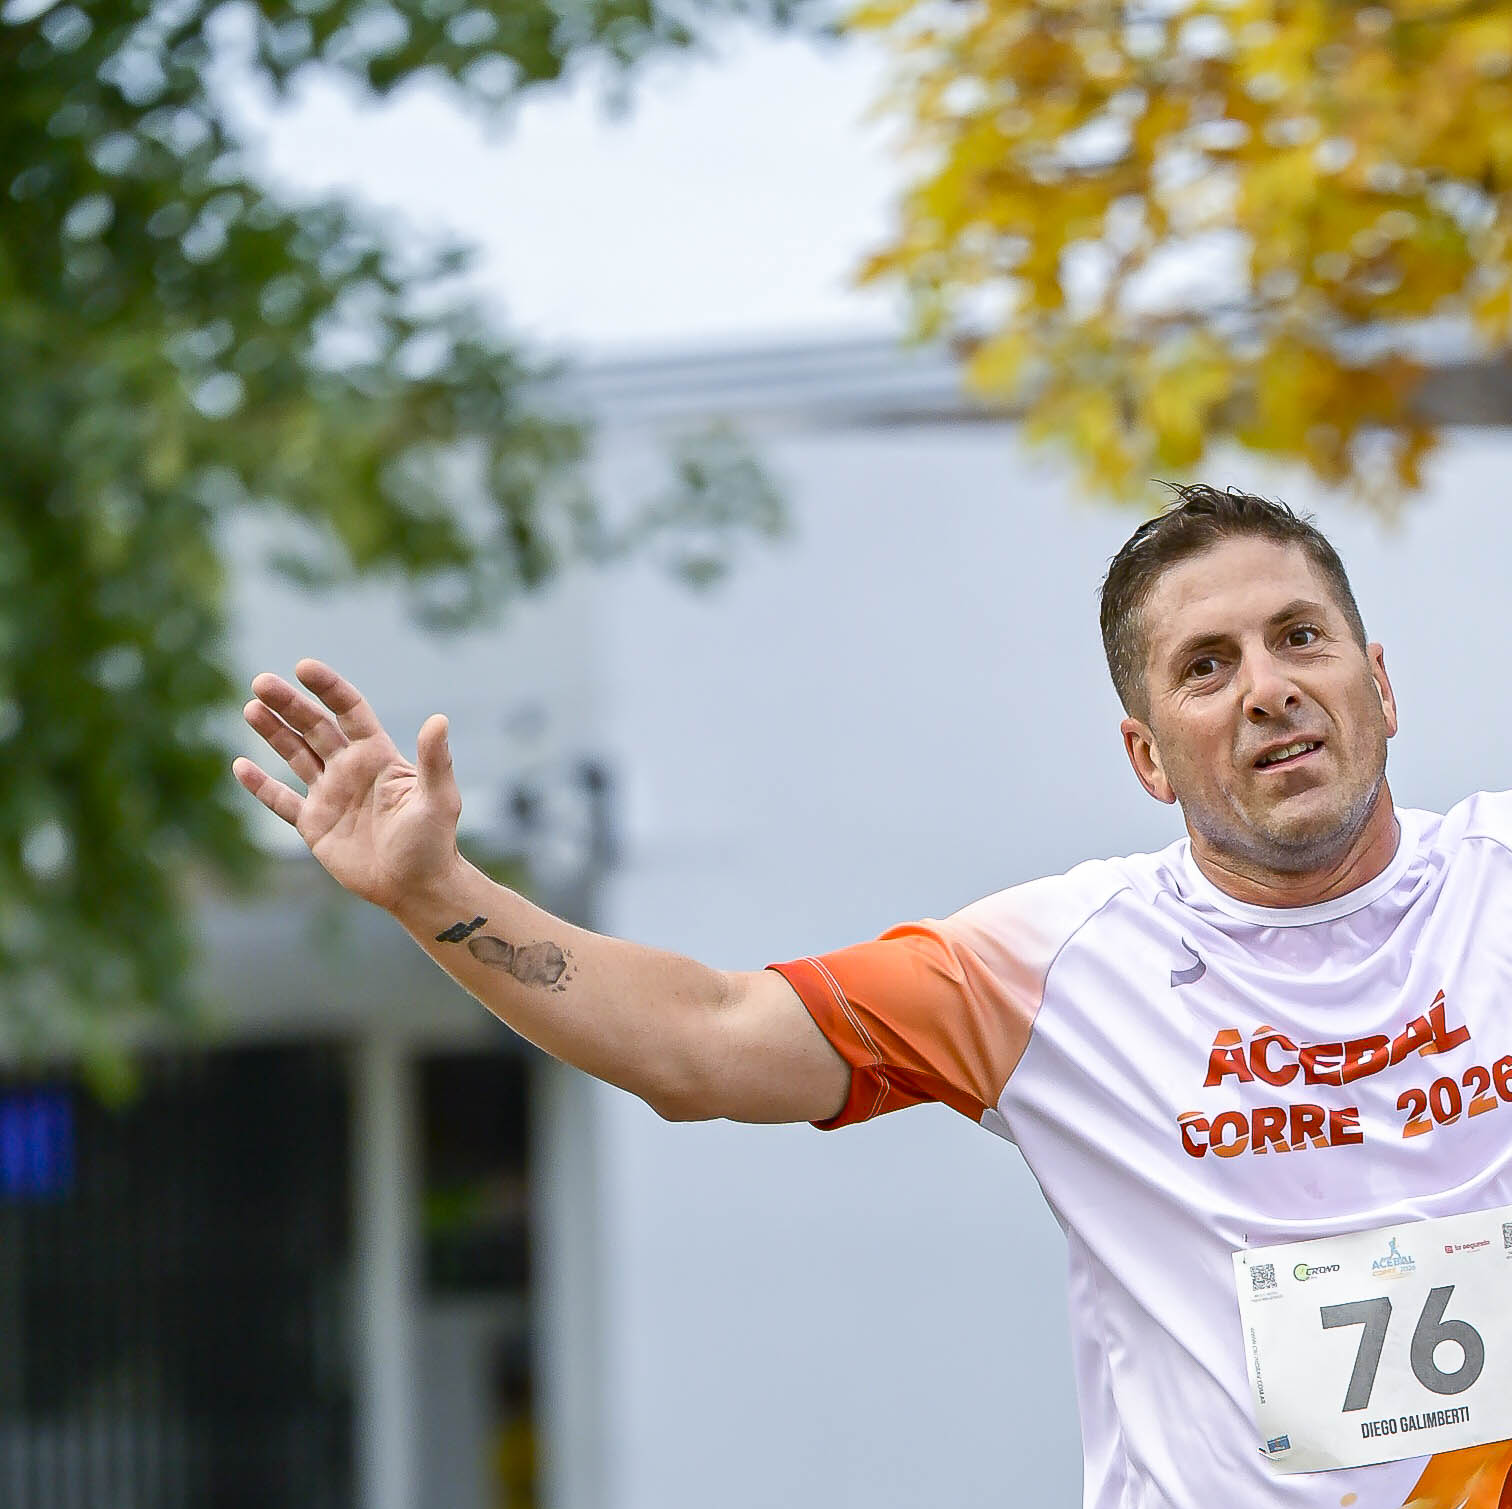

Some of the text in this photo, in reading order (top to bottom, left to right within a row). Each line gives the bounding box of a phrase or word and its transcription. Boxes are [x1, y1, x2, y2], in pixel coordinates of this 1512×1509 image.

[1176, 1104, 1364, 1158] CORRE
[1320, 1285, 1485, 1412] 76
[1360, 1406, 1470, 1438] DIEGO GALIMBERTI
